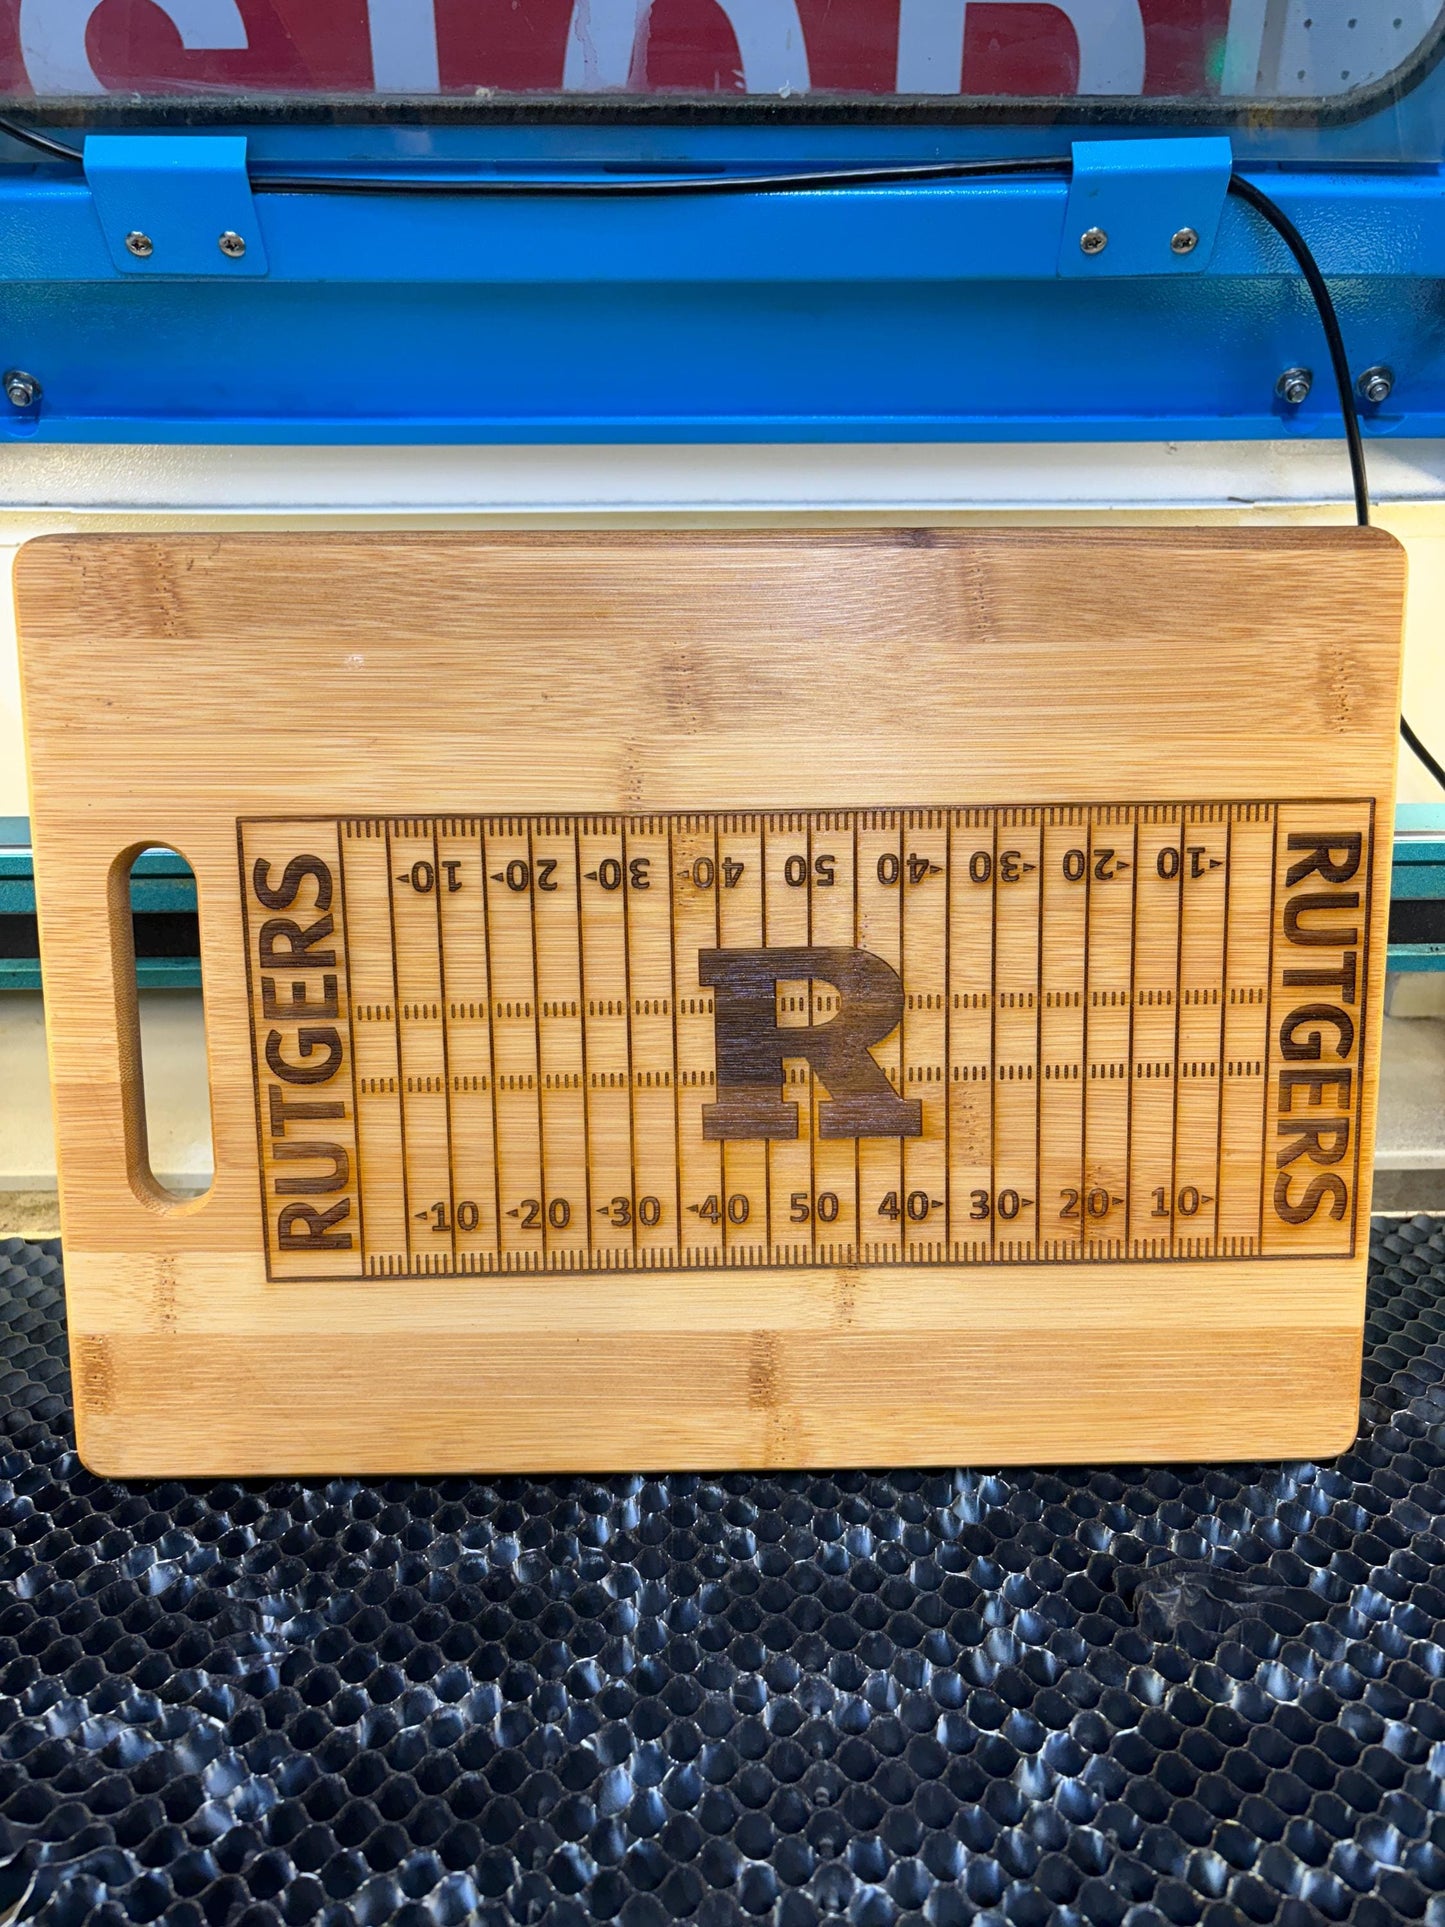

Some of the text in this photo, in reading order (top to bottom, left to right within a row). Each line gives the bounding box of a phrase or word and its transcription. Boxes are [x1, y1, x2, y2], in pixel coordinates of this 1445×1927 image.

[412, 860, 463, 893] 10
[506, 859, 558, 892] 20
[599, 858, 650, 890] 30
[693, 857, 744, 889] 40
[784, 854, 836, 886] 50
[877, 852, 929, 885] 40
[970, 850, 1022, 883] 30
[1063, 849, 1116, 881] 20
[1157, 847, 1206, 879] 10
[698, 947, 922, 1140] R
[1273, 832, 1363, 1225] RUTGERS
[253, 854, 353, 1251] RUTGERS
[431, 1201, 479, 1232] 10
[520, 1199, 571, 1229] 20
[611, 1196, 661, 1227] 30
[699, 1195, 749, 1225] 40
[790, 1192, 838, 1222] 50
[878, 1191, 929, 1220] 40
[970, 1189, 1020, 1219] 30
[1060, 1188, 1109, 1219] 20
[1151, 1186, 1199, 1216] 10
